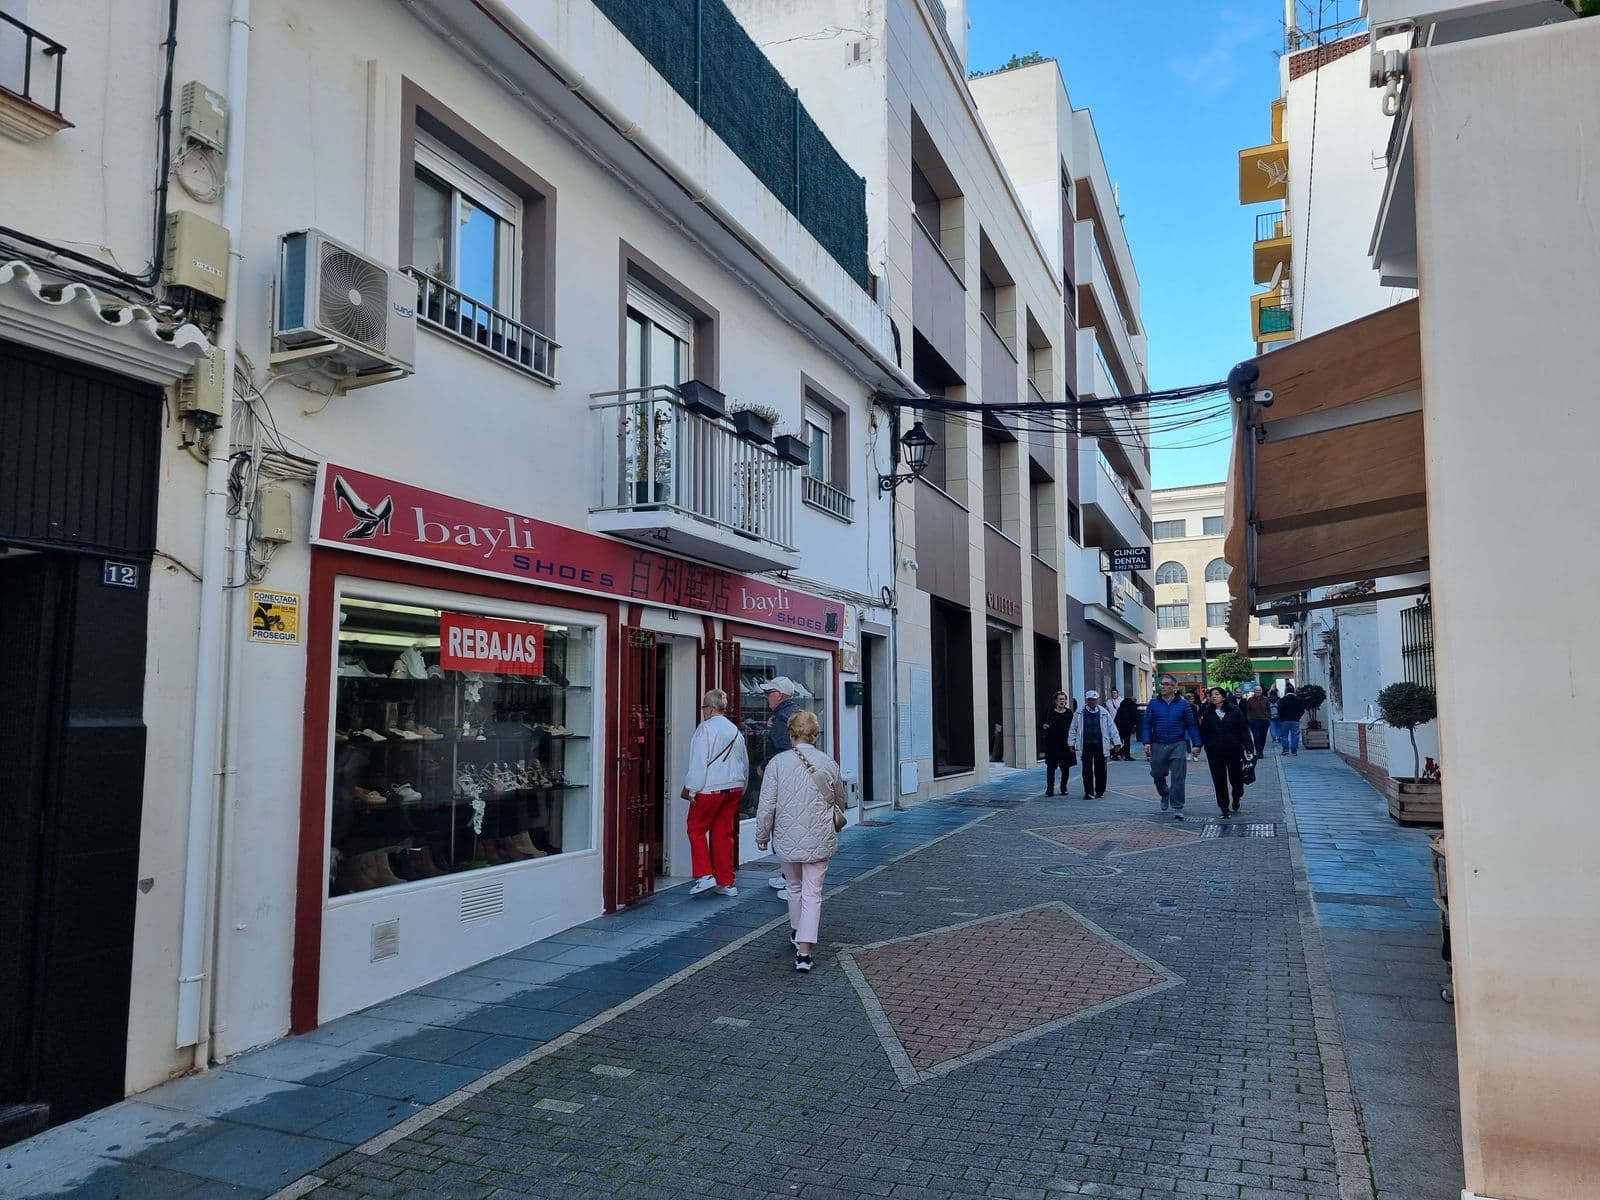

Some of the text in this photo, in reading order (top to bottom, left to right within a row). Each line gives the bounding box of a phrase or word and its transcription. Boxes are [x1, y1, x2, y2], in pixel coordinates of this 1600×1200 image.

[411, 506, 536, 558] bayli
[1114, 548, 1146, 557] CLINICA
[1115, 557, 1146, 565] DENTAL
[108, 566, 134, 584] 12
[512, 554, 615, 588] SHOES
[253, 592, 297, 603] CONECTADA
[741, 588, 791, 617] bayli
[777, 612, 823, 631] SHOES
[252, 630, 296, 641] PROSEGUR
[448, 626, 536, 664] REBAJAS
